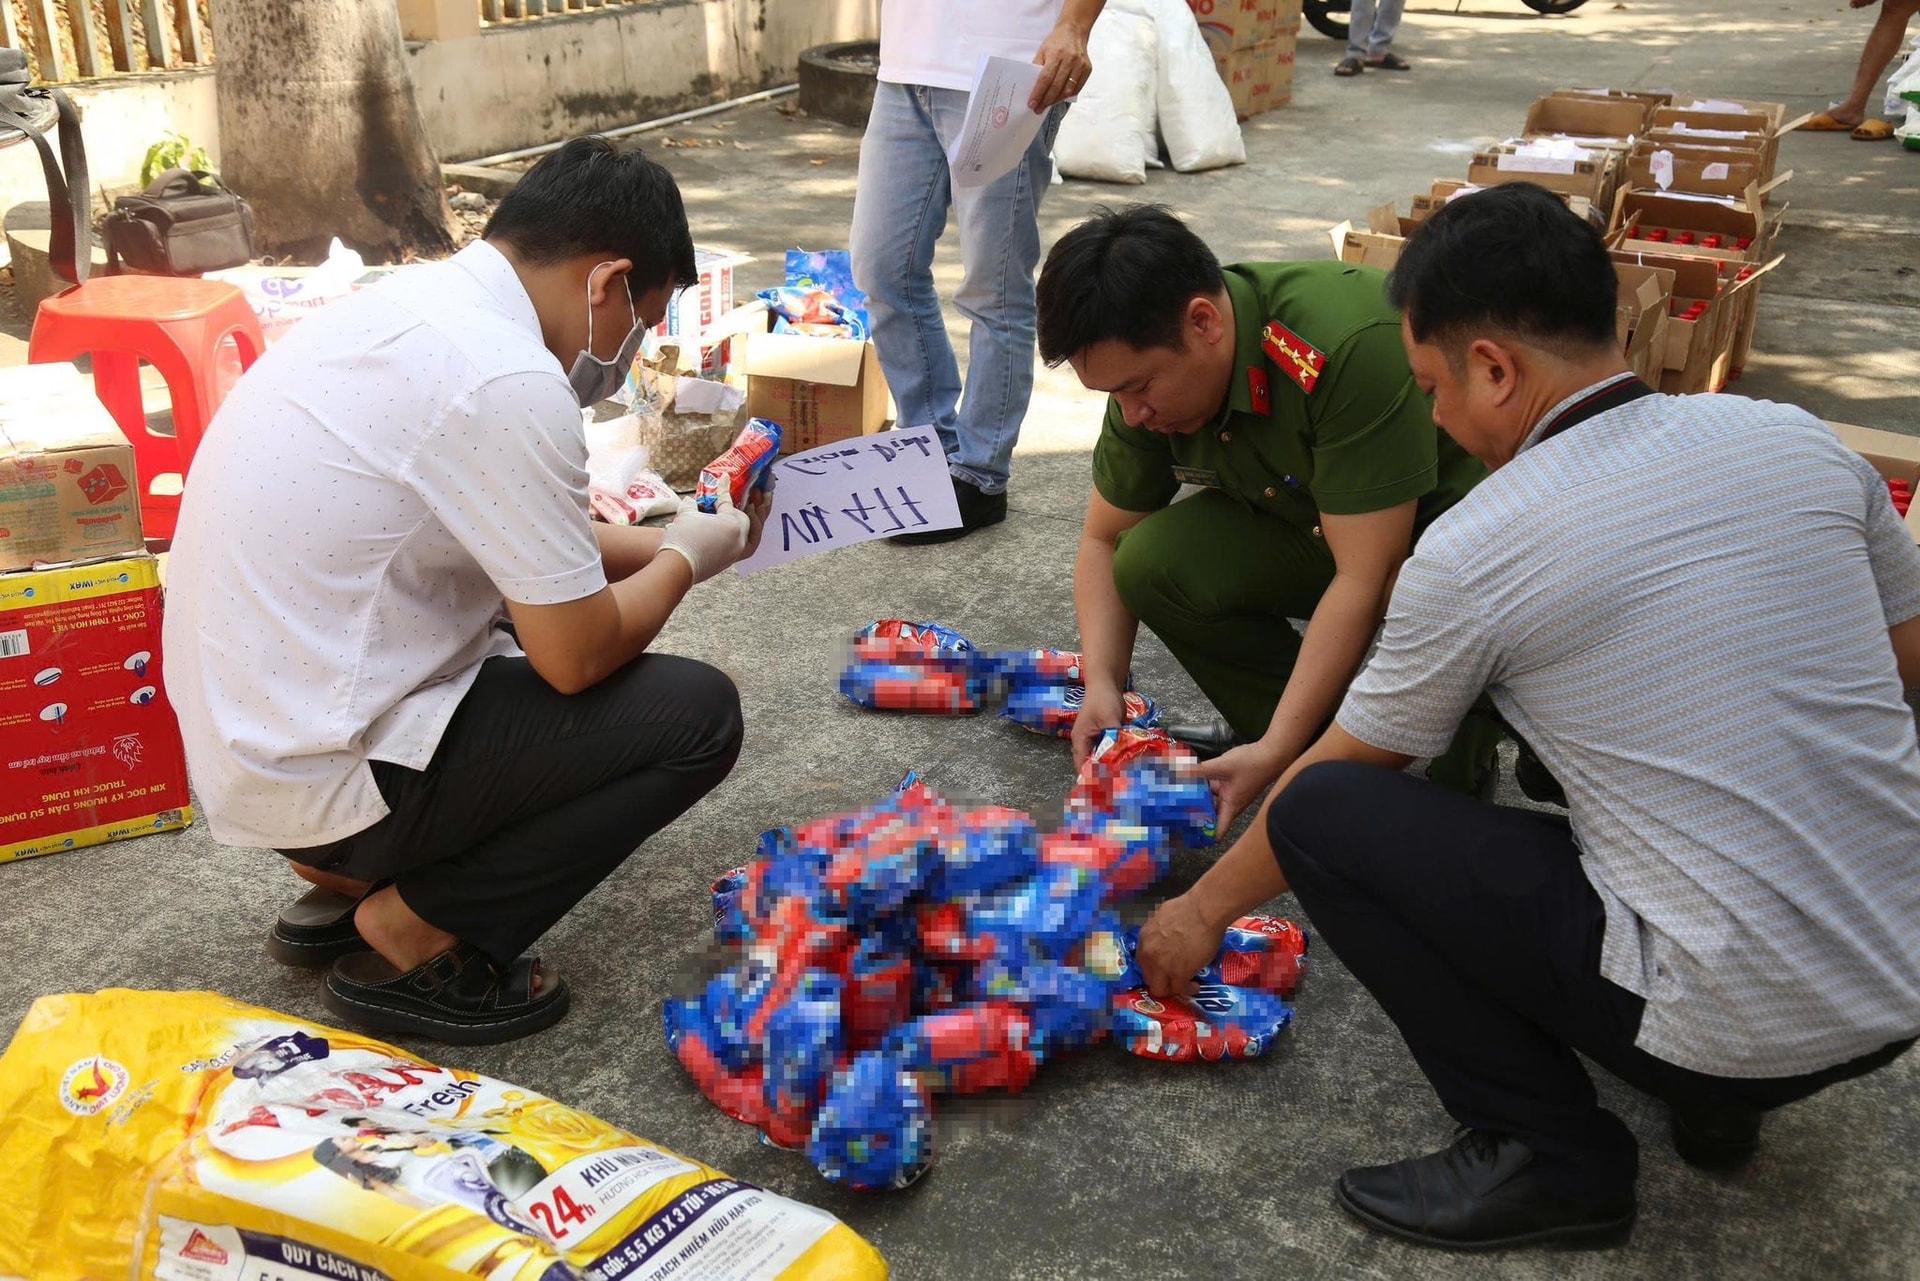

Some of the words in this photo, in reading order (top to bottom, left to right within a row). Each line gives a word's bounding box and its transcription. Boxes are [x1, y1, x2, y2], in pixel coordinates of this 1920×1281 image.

[700, 271, 712, 326] GOLD
[111, 614, 121, 623] TY
[74, 787, 90, 796] KHI
[127, 787, 146, 798] ĐỌC
[150, 783, 166, 793] XIN
[403, 1079, 483, 1118] Fresh
[602, 1254, 629, 1276] GÓI:
[624, 1238, 647, 1263] 5,5
[643, 1223, 667, 1247] KG
[661, 1215, 677, 1232] X
[672, 1207, 686, 1223] 3
[680, 1193, 705, 1215] TÚI
[679, 1232, 710, 1261] NHIỆM
[707, 1216, 730, 1237] HỮU
[727, 1203, 748, 1220] HẠN
[281, 1242, 312, 1266] QUY
[317, 1250, 359, 1280] CÁCH
